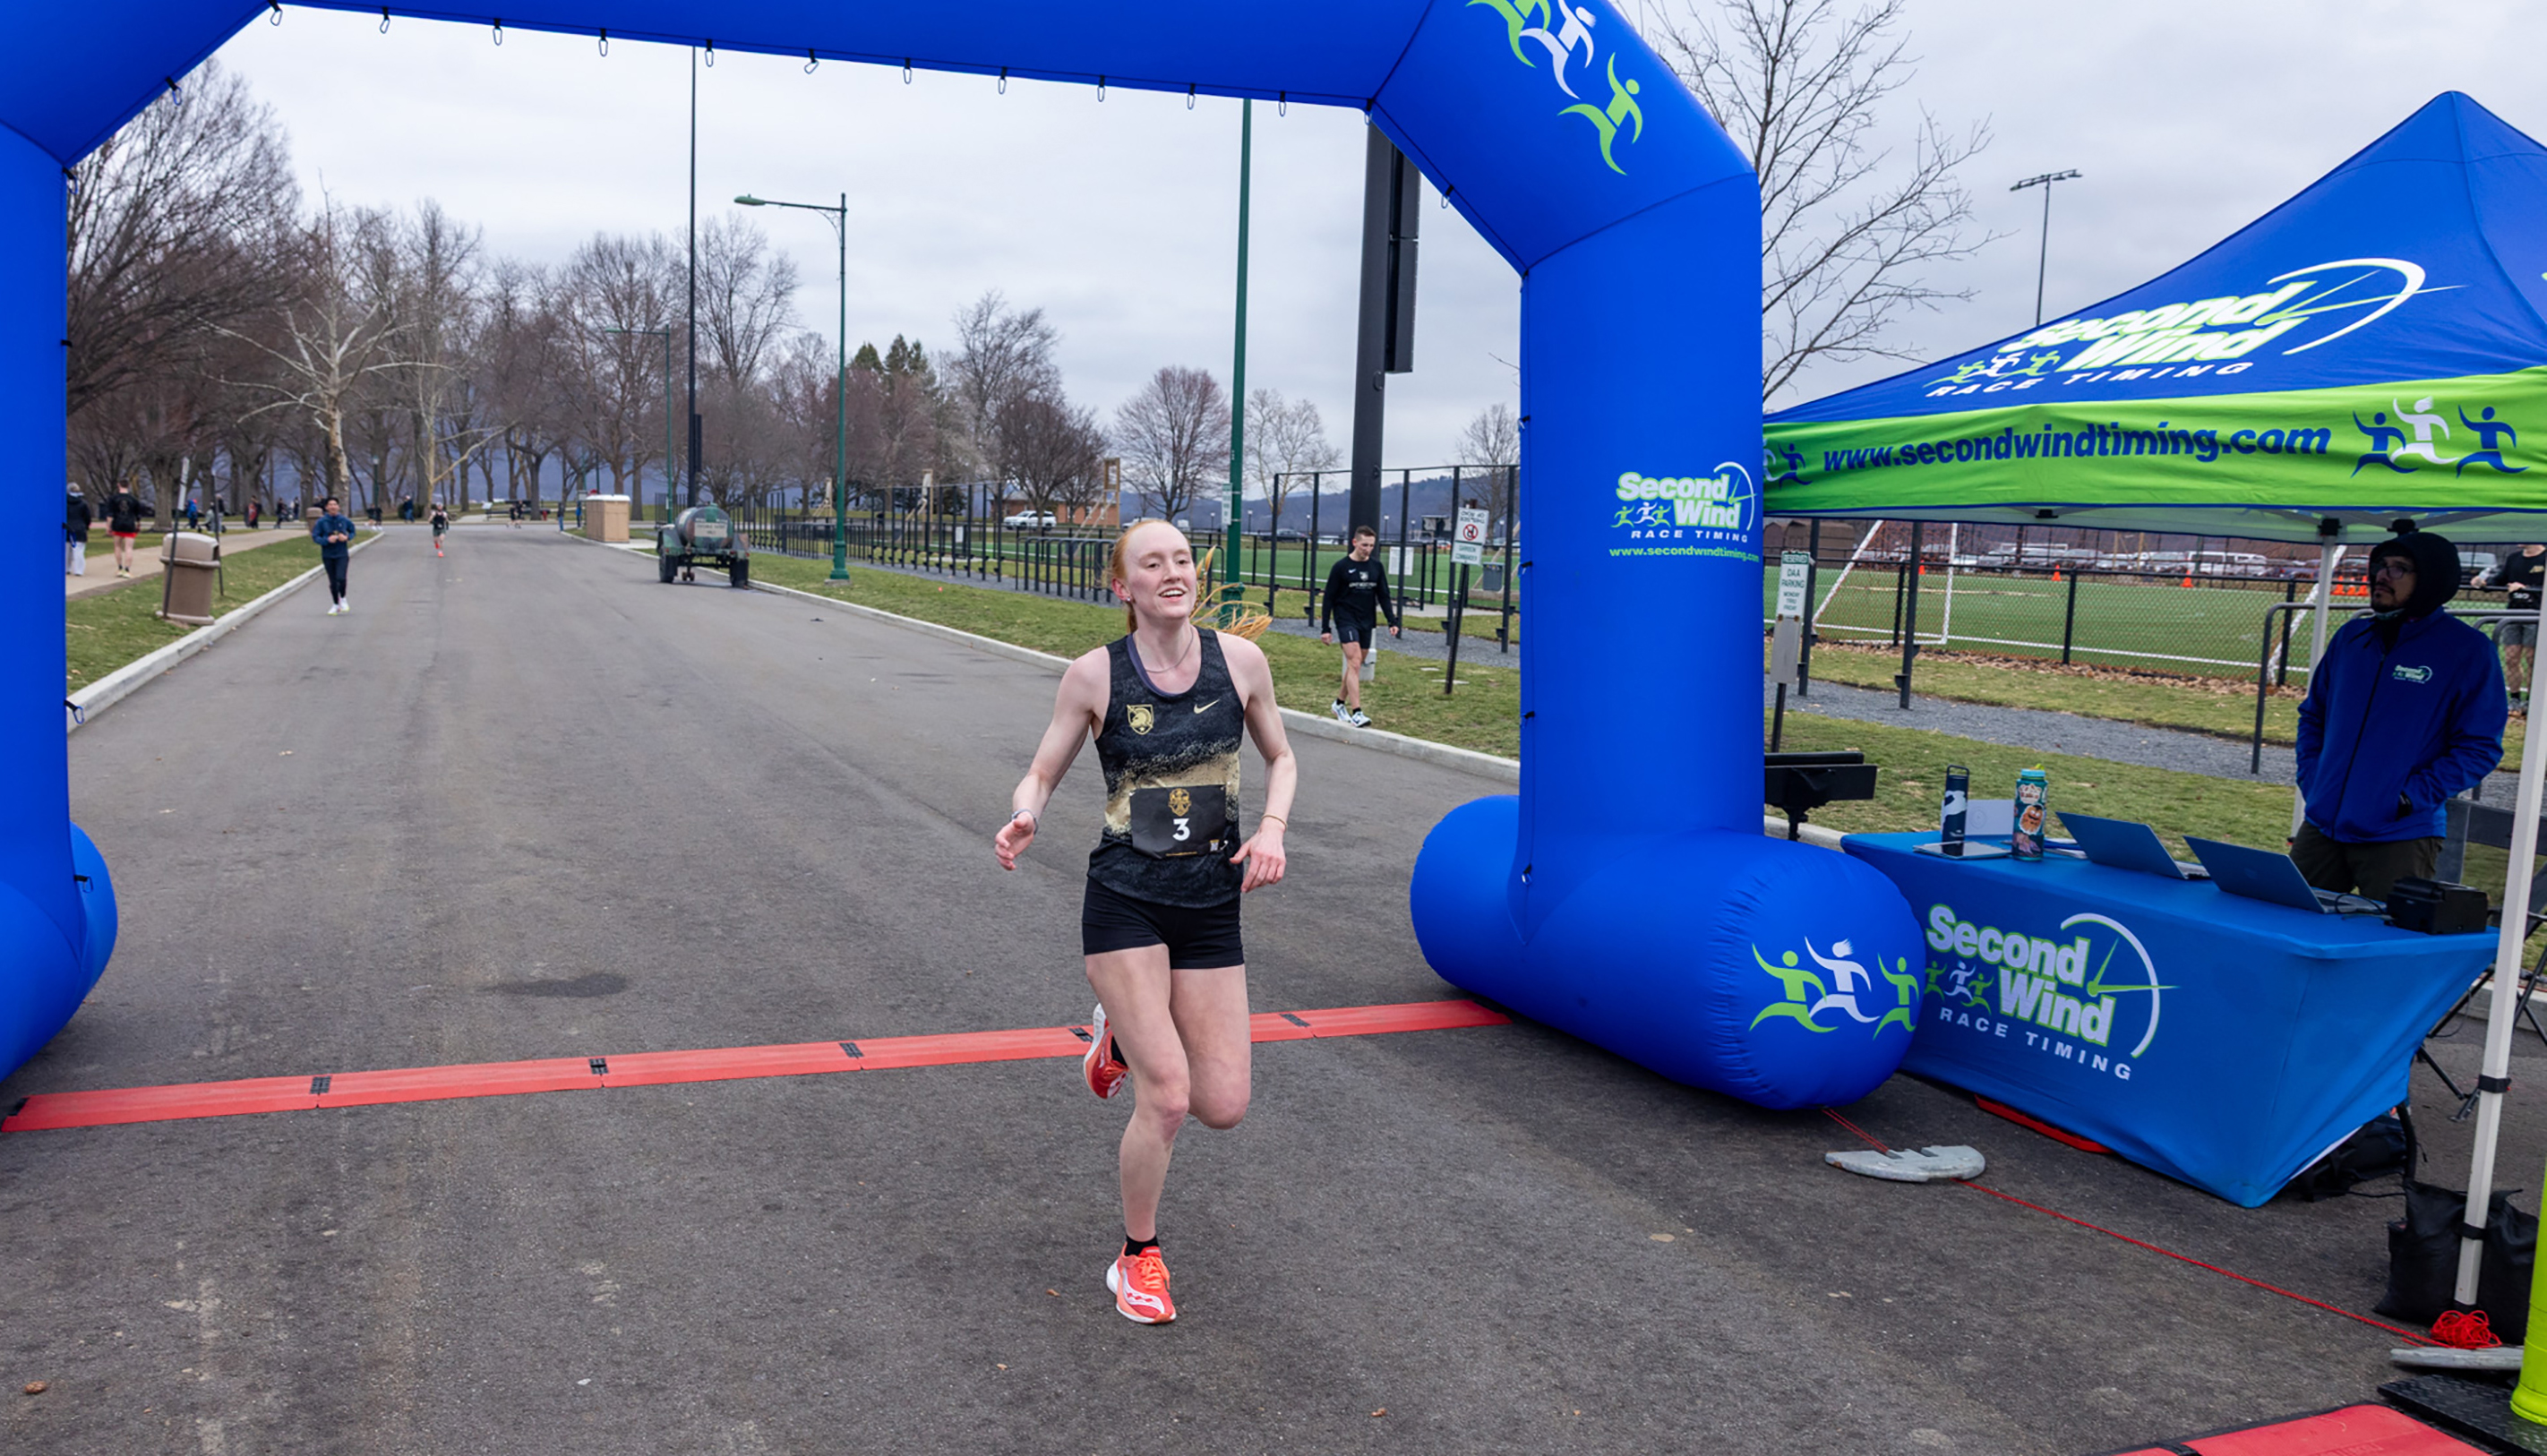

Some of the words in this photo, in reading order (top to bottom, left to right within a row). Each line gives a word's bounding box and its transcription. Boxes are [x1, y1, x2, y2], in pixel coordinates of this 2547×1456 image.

[1998, 281, 2318, 353] Second
[2054, 317, 2309, 373] Wind
[1925, 378, 2044, 397] RACE
[2063, 362, 2253, 385] TIMING
[1823, 421, 2331, 472] www.secondwindtiming.com
[1616, 472, 1730, 501] Second
[1673, 498, 1741, 529] Wind
[1631, 529, 1683, 538] RACE
[1695, 530, 1748, 543] TIMING
[1781, 578, 1805, 588] PARKING
[1172, 818, 1191, 841] 3
[1926, 904, 2090, 988] Second
[1999, 965, 2116, 1047] Wind
[1939, 1006, 2009, 1038] RACE
[2026, 1032, 2131, 1081] TIMING
